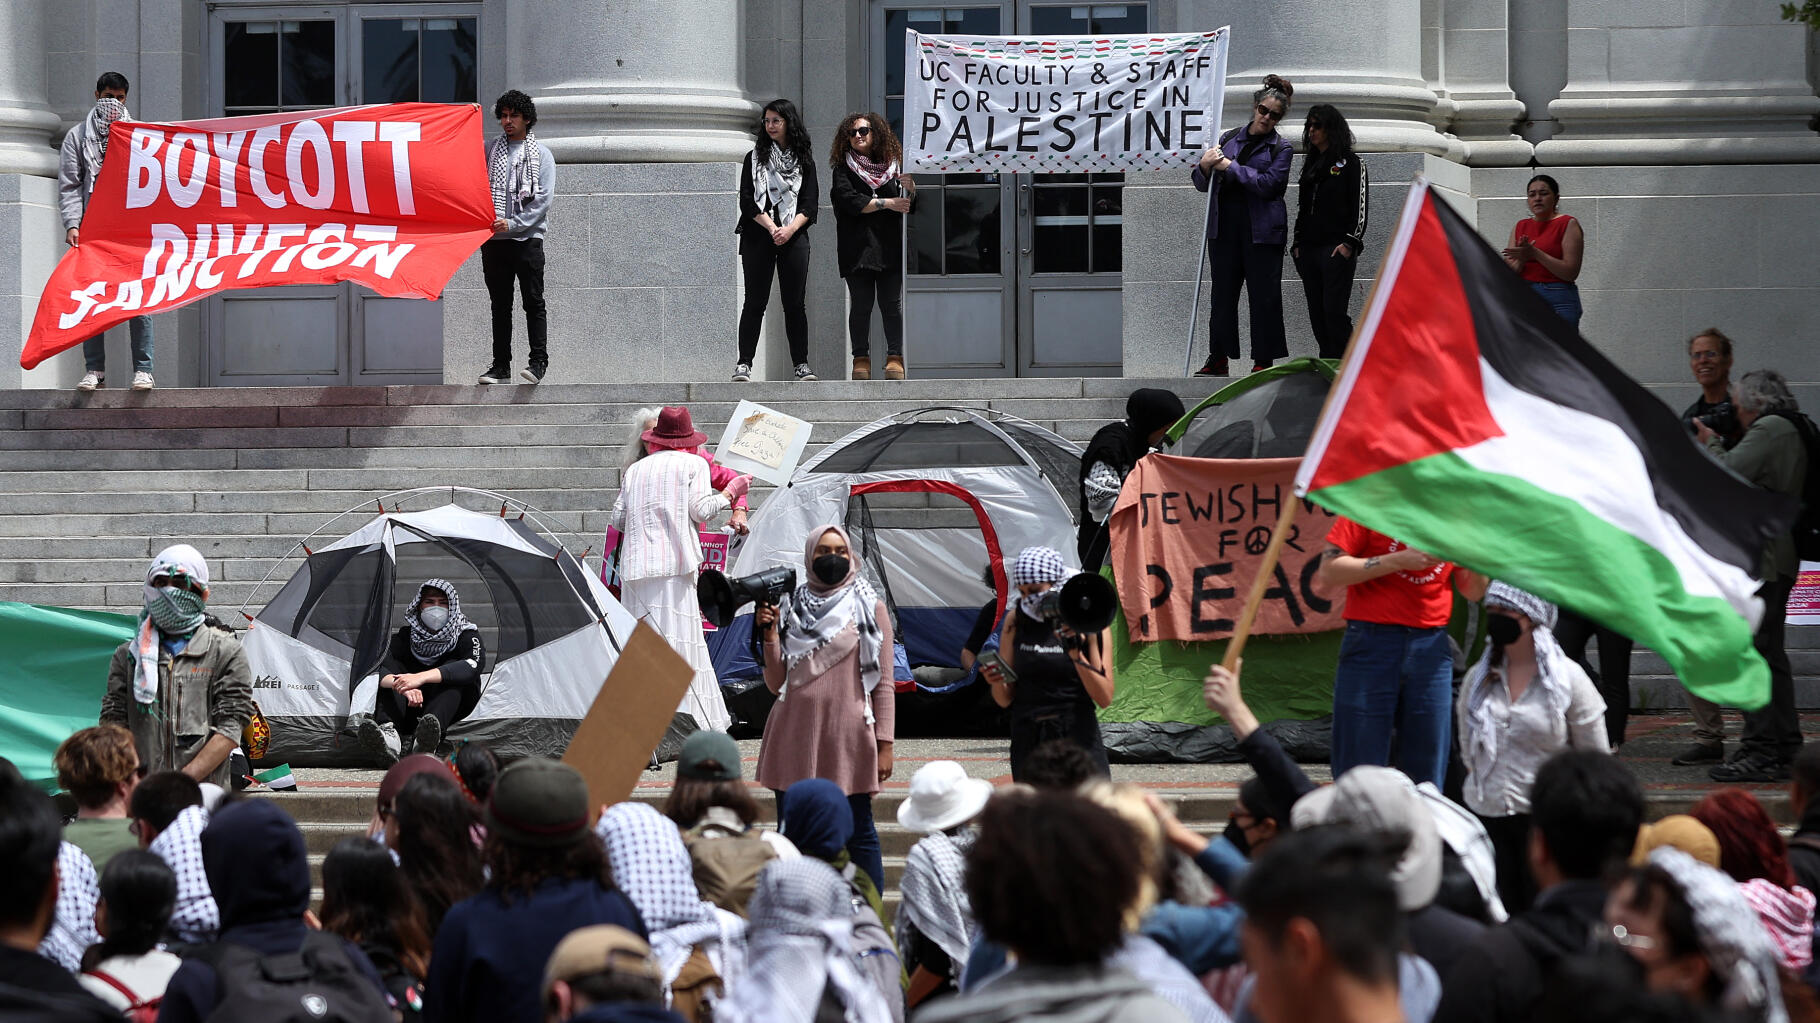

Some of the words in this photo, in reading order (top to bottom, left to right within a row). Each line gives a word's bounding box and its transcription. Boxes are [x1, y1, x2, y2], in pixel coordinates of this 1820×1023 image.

[920, 59, 950, 83] UC
[965, 63, 1073, 85] FACULTY
[1092, 62, 1109, 84] &
[1127, 57, 1209, 81] STAFF
[933, 88, 989, 112] FOR
[1008, 89, 1147, 113] JUSTICE
[1162, 86, 1189, 106] IN
[920, 110, 1204, 152] PALESTINE
[126, 120, 421, 215] BOYCOTT
[1034, 644, 1064, 654] Palestin
